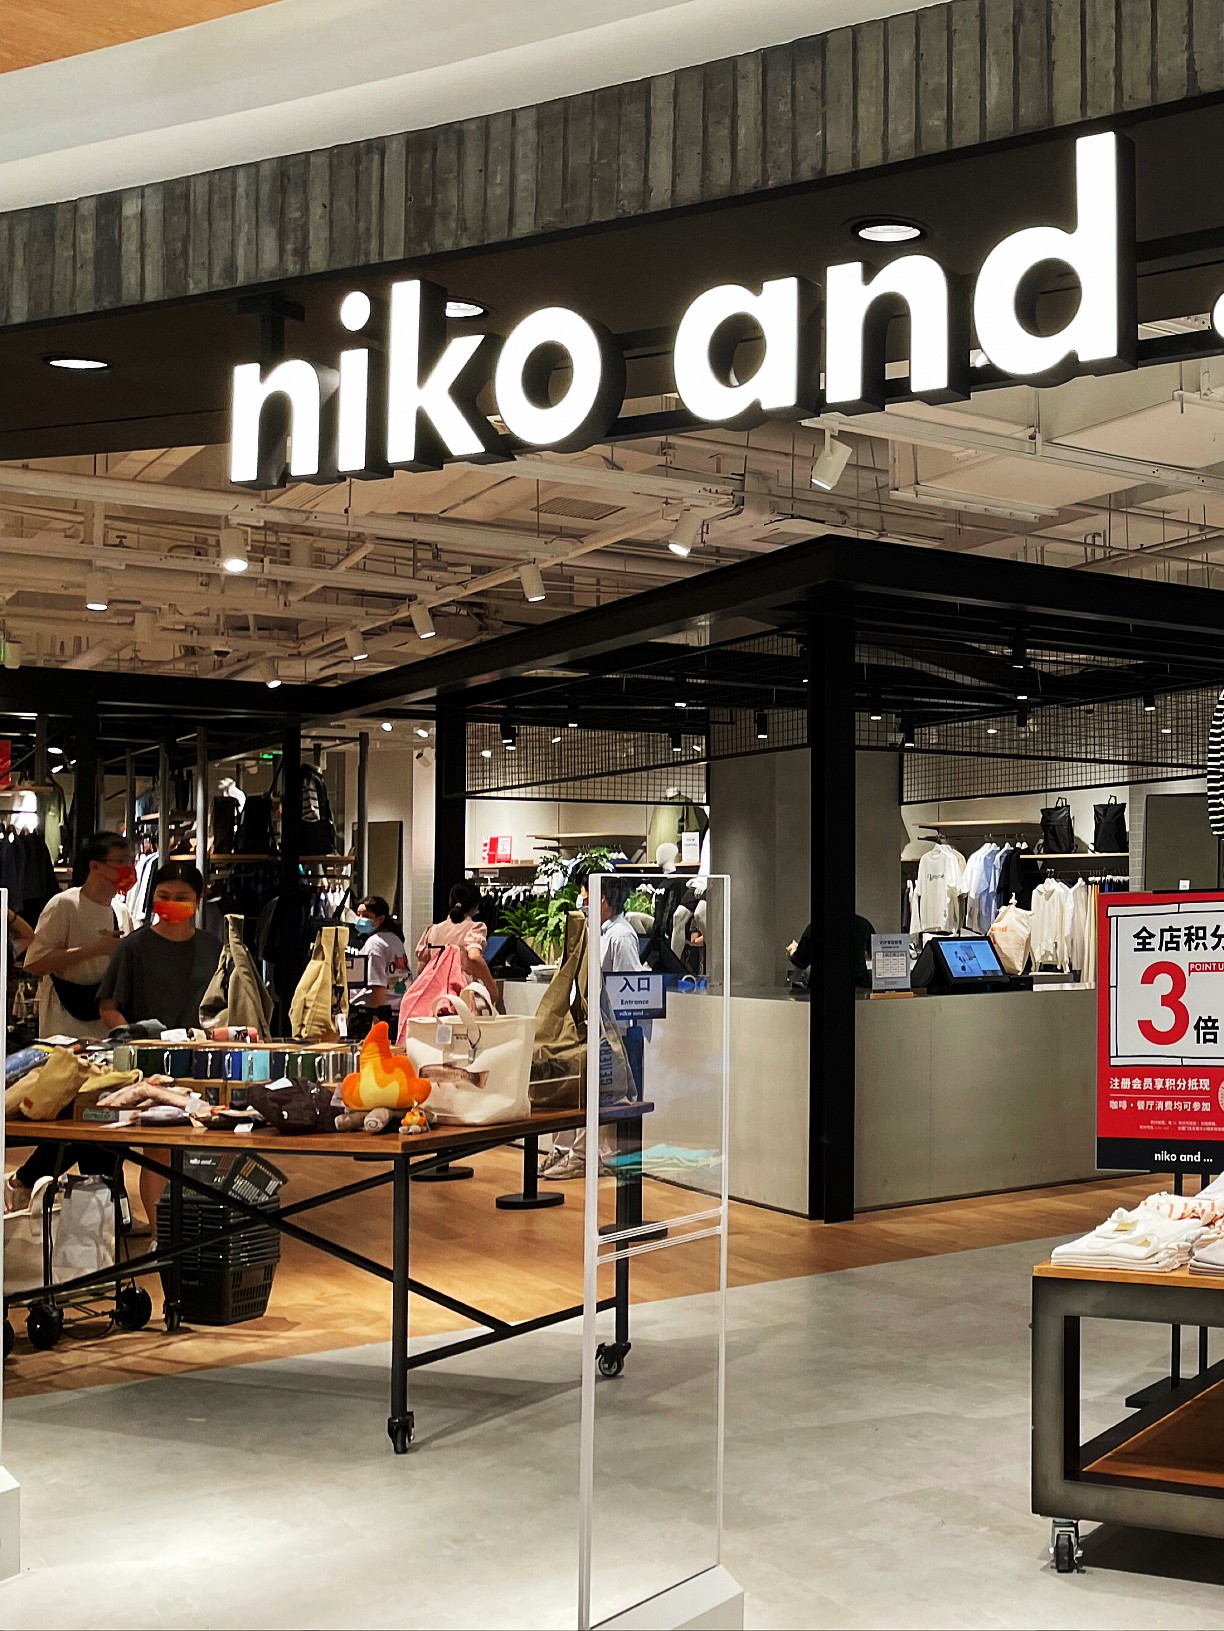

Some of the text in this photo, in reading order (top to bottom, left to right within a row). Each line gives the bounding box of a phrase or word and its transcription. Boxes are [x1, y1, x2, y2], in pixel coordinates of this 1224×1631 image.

[229, 280, 602, 484] niko
[672, 131, 1121, 423] and
[1190, 963, 1216, 971] POINT
[620, 977, 650, 992] 入口
[1110, 1077, 1210, 1091] 注册会员享积分抵现
[1154, 1150, 1177, 1162] niko
[1179, 1151, 1201, 1162] and
